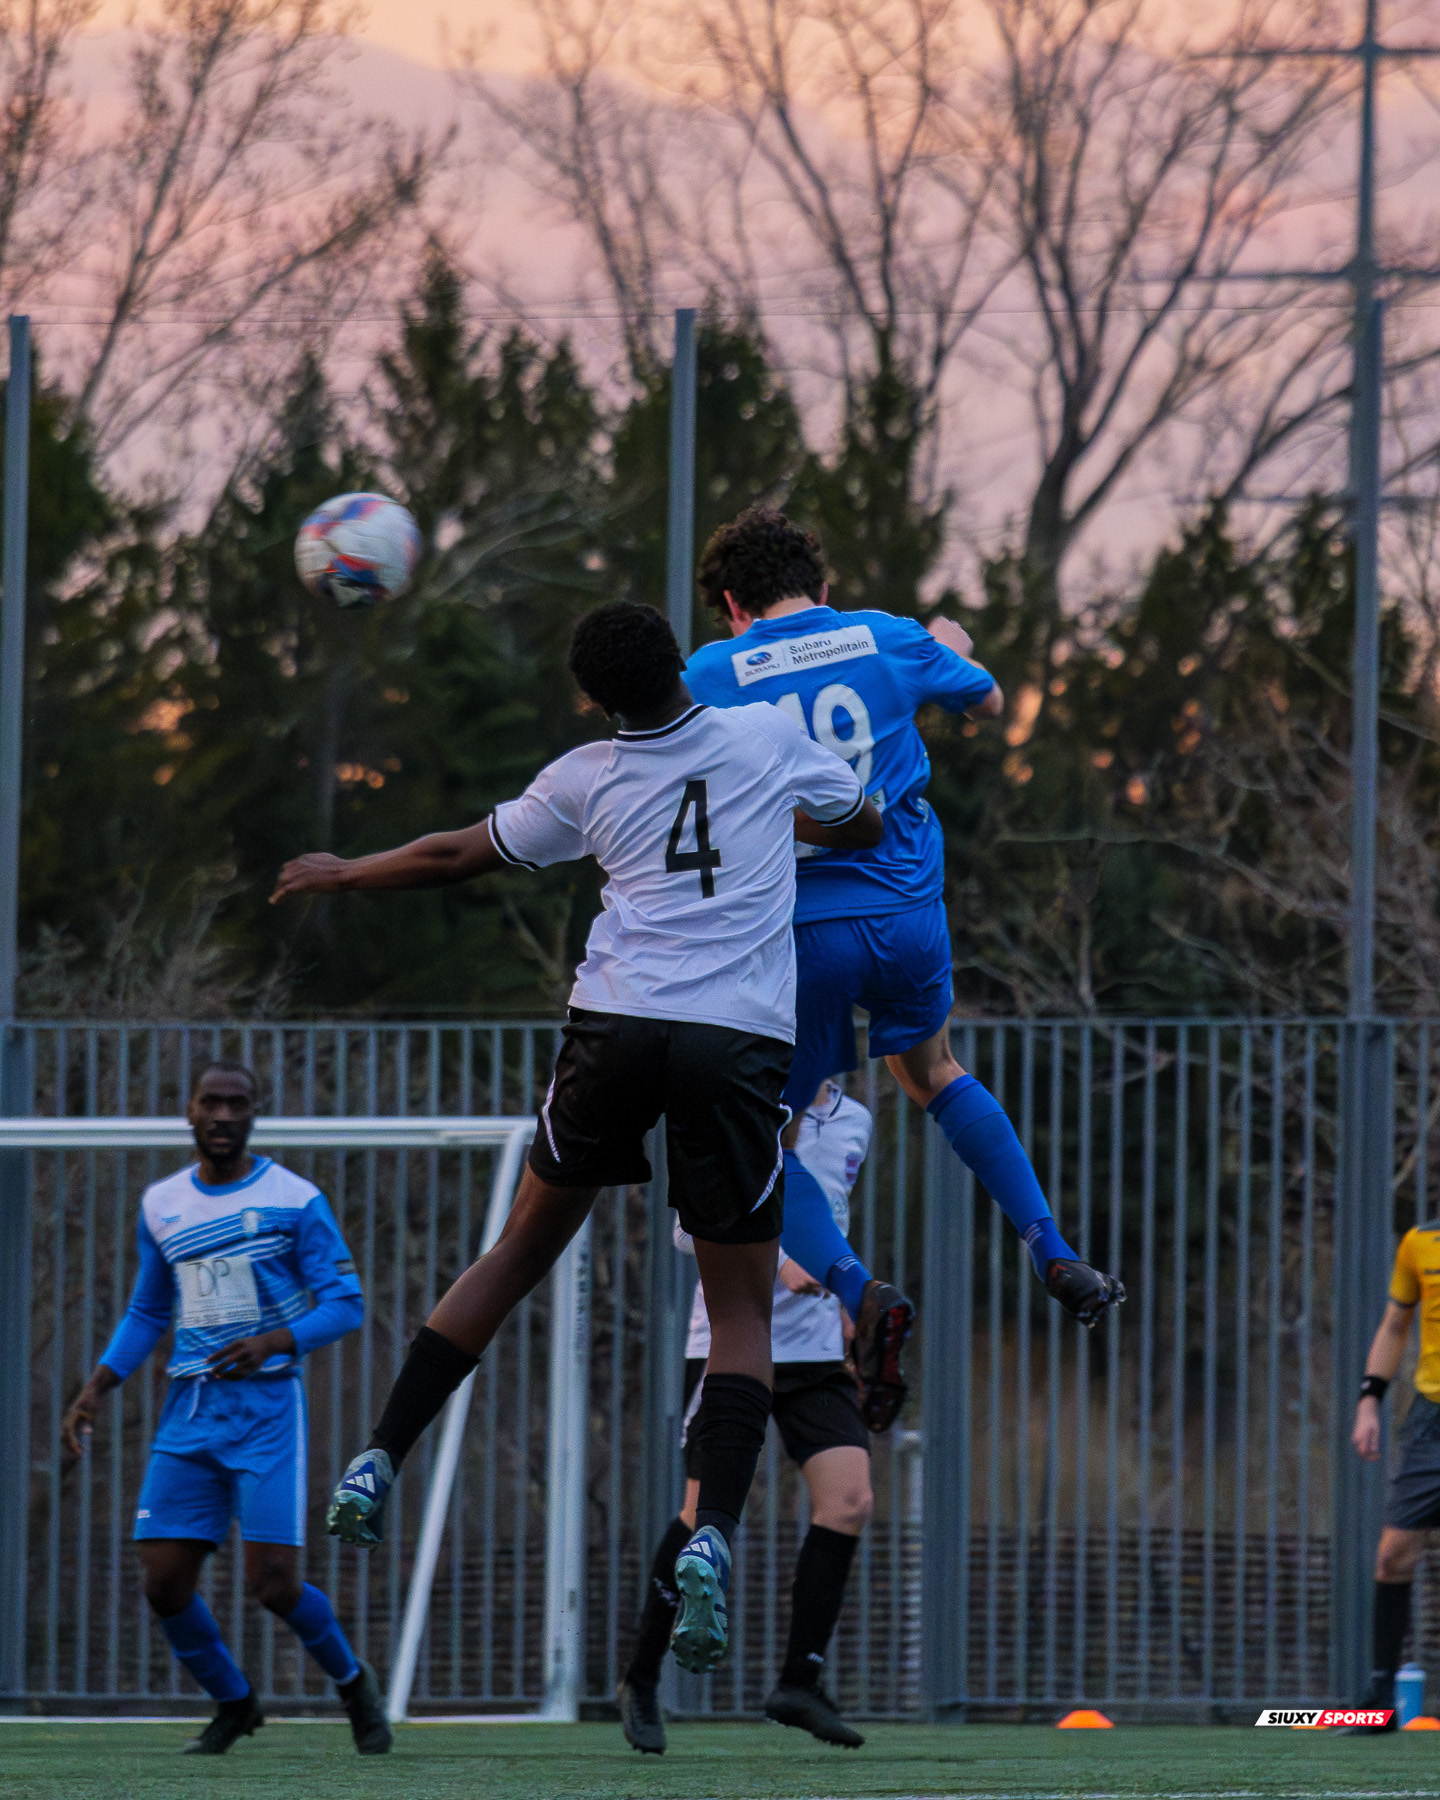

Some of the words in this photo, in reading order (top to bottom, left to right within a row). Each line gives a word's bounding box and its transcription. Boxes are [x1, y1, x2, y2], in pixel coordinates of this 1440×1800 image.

[789, 639, 832, 655] Subaru
[791, 640, 869, 665] Métropolitain
[665, 779, 722, 899] 4
